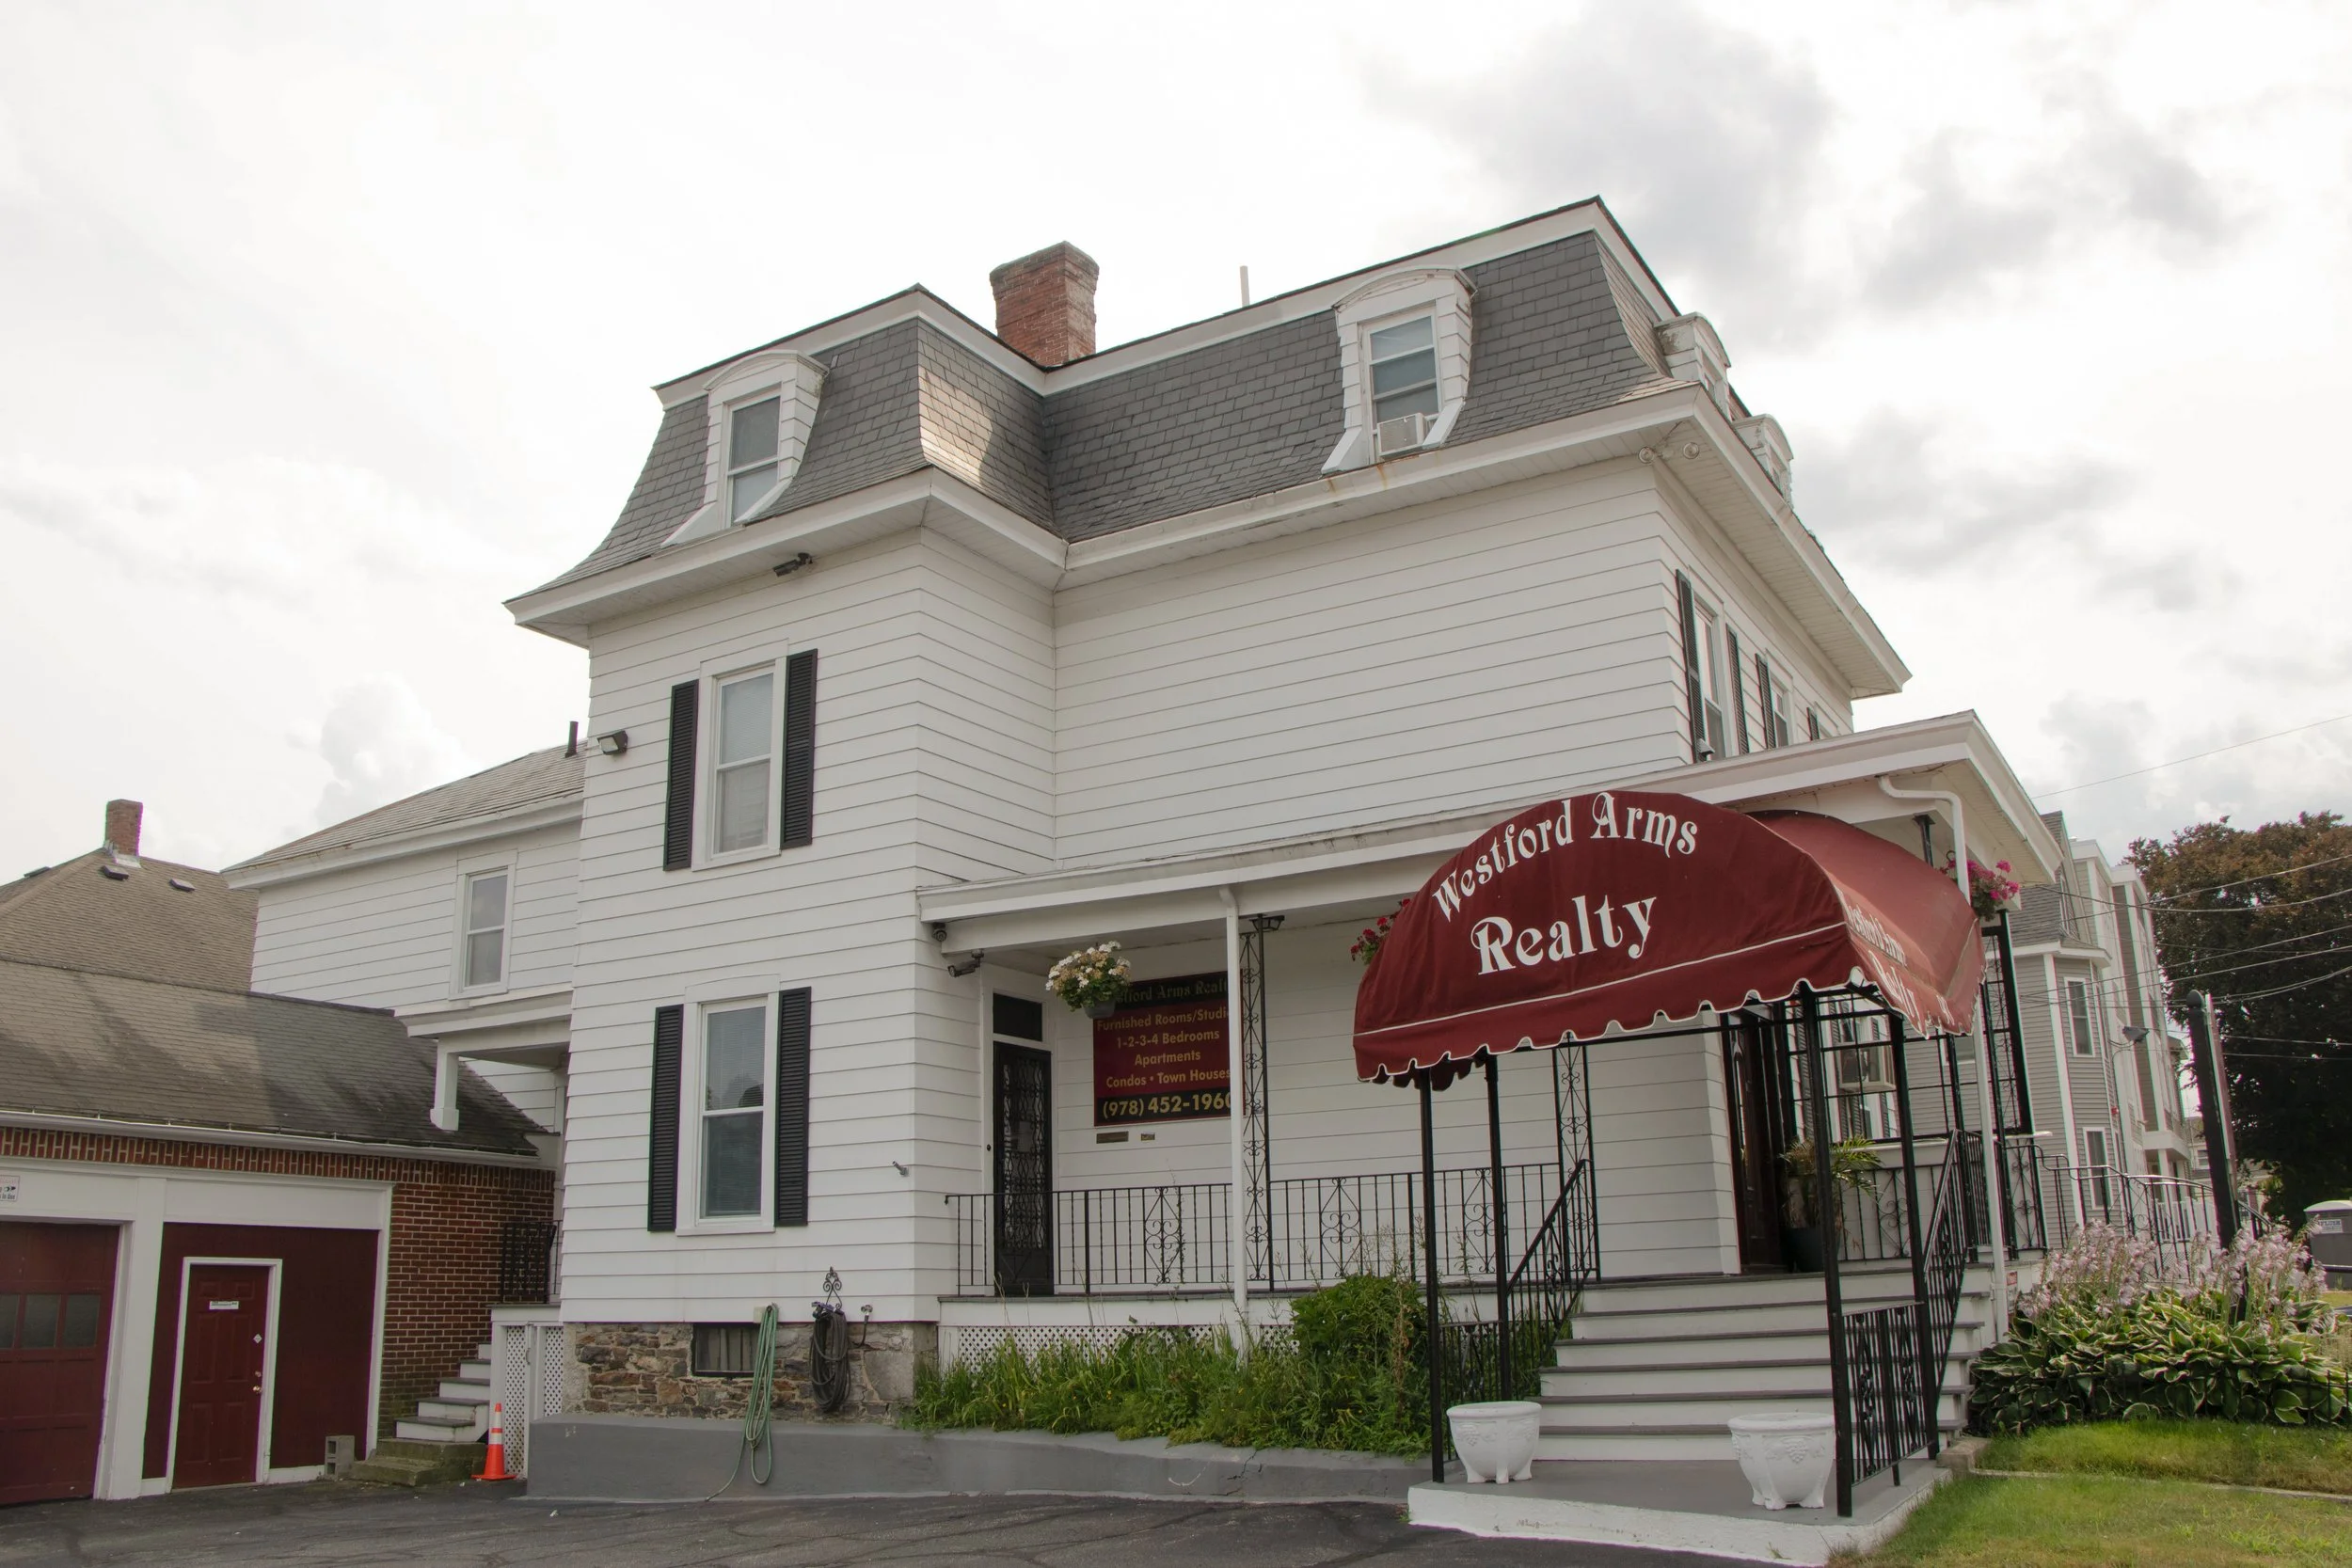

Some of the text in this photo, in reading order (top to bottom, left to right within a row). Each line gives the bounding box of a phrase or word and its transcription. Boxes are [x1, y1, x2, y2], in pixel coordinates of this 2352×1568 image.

[1432, 792, 1697, 923] Westford Arms
[1470, 895, 1657, 974] Realty
[1159, 985, 1190, 999] Arms
[1196, 979, 1228, 995] Realt
[1097, 1015, 1151, 1031] Furnished
[1117, 1030, 1220, 1049] 1-2-3-4 Bedrooms
[1135, 1050, 1200, 1068] Apartments
[1106, 1075, 1147, 1088] Condos
[1157, 1071, 1185, 1084] Town
[1103, 1098, 1144, 1118] (978)
